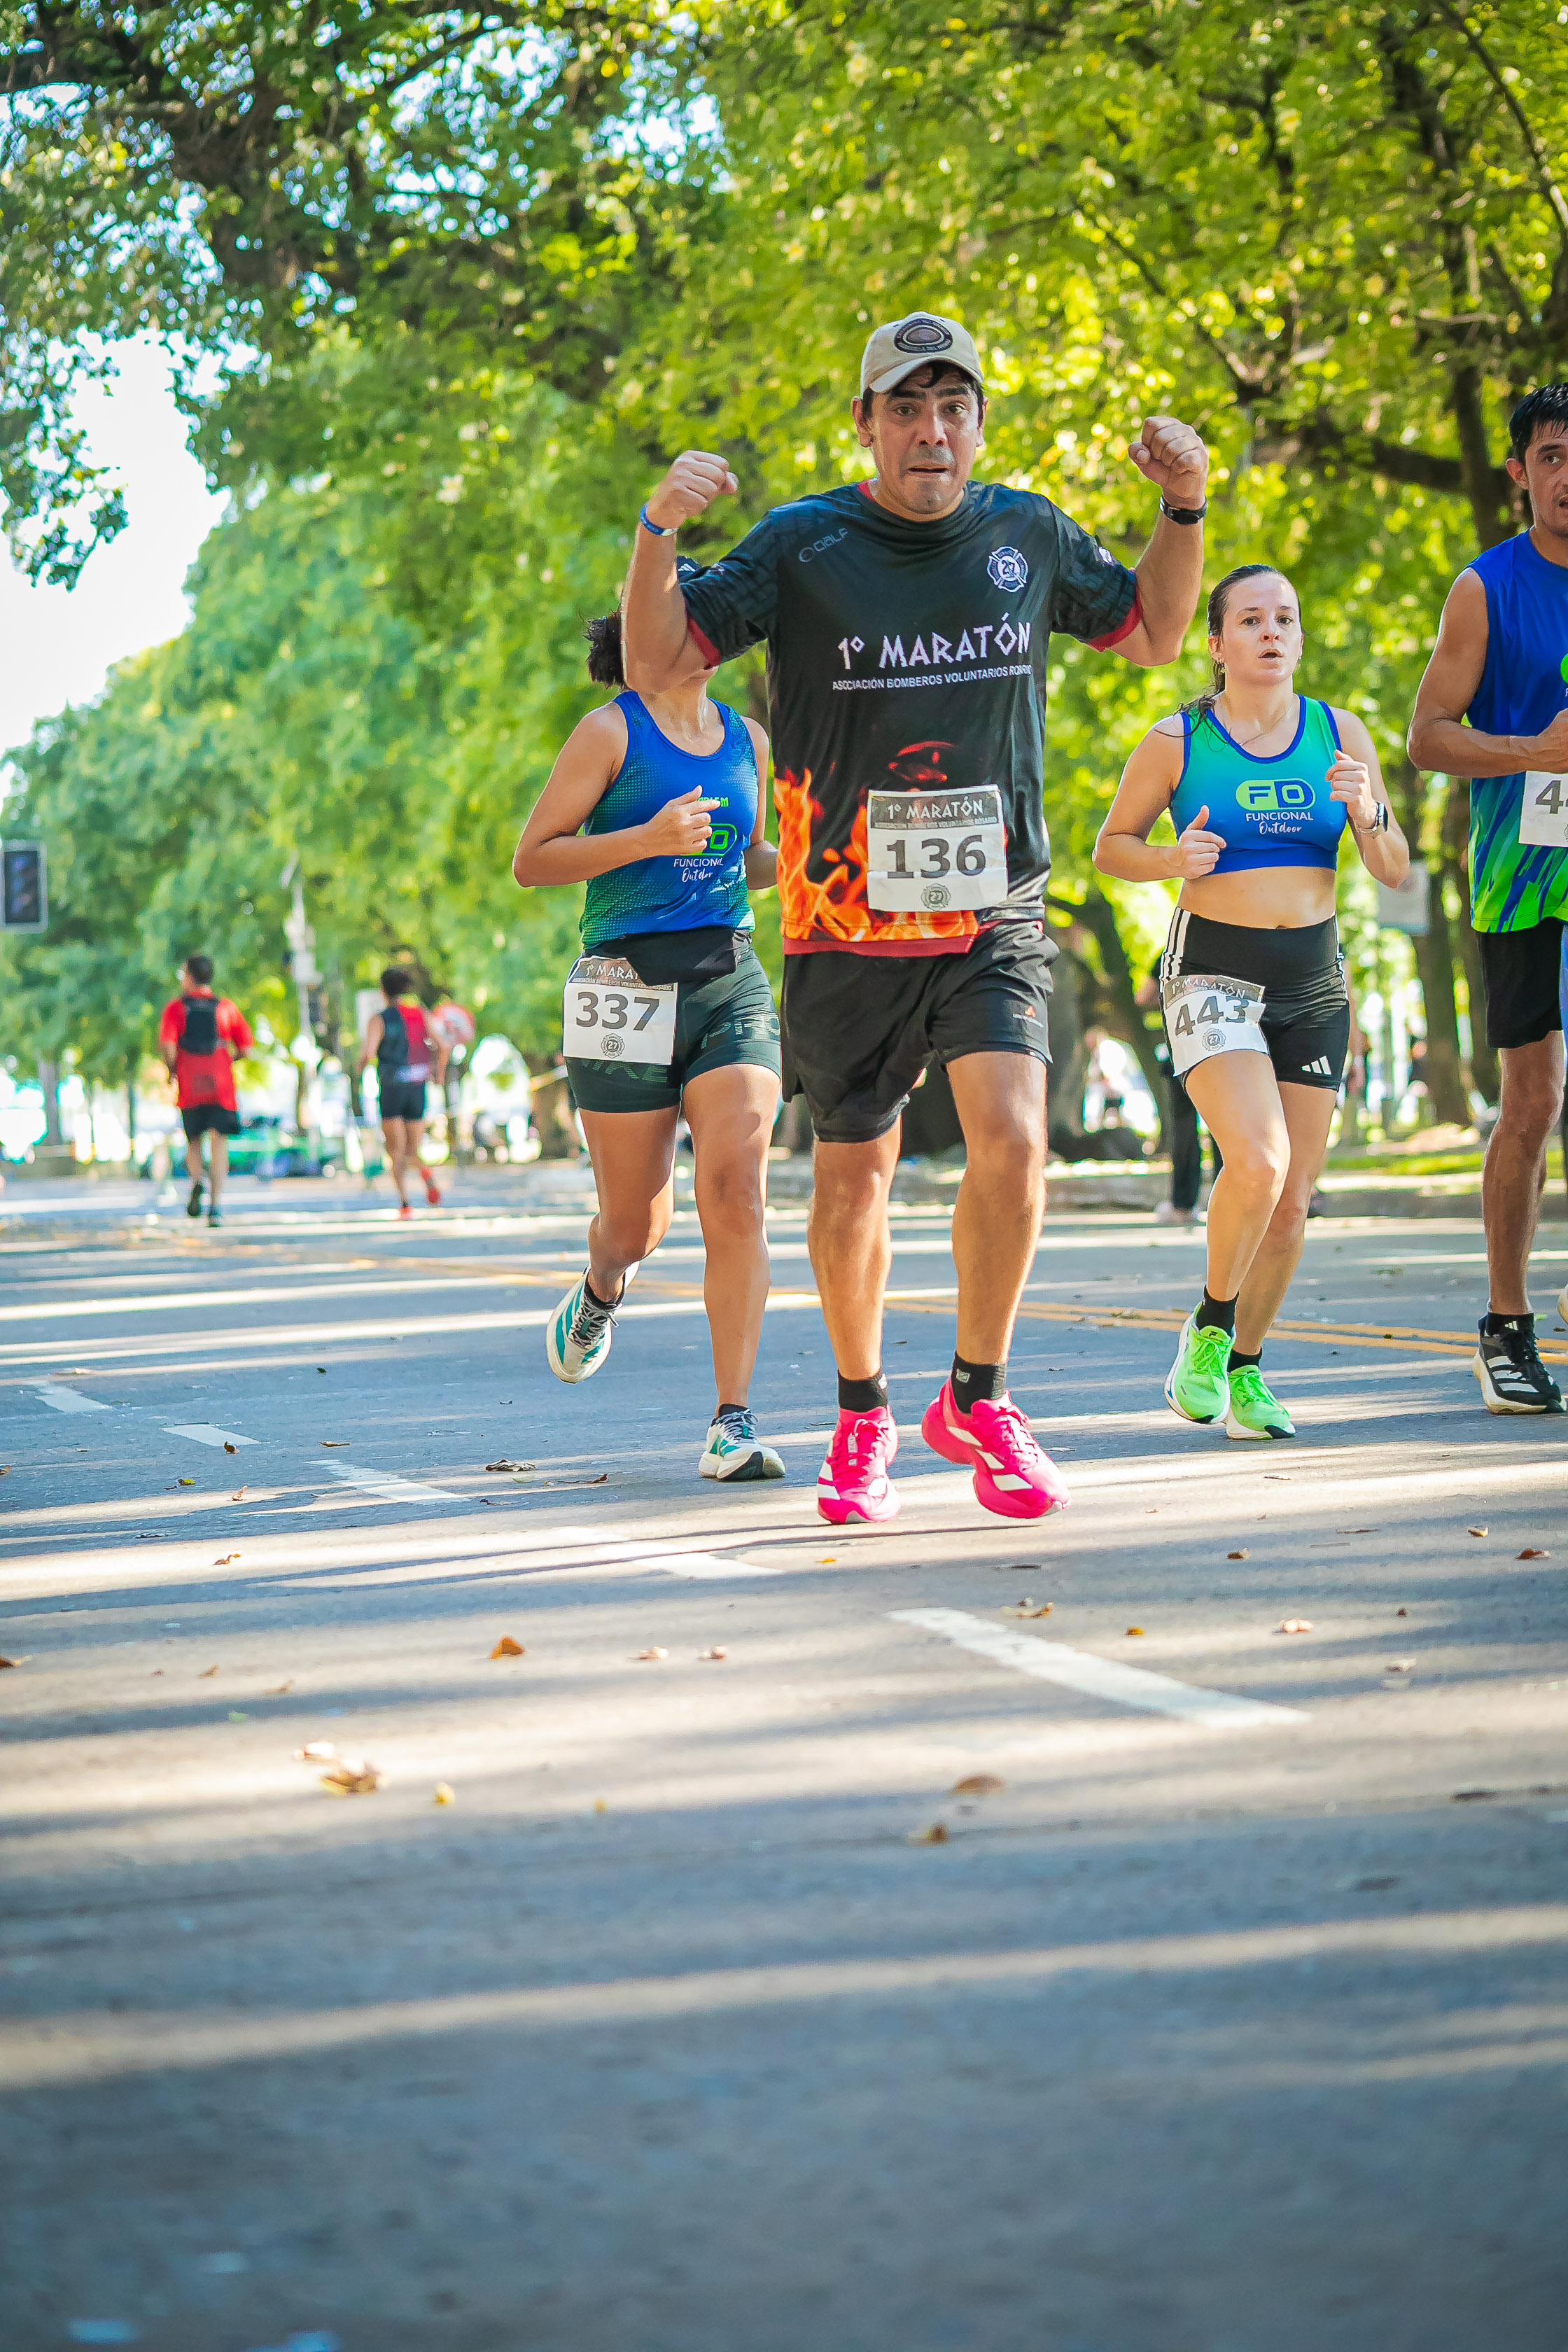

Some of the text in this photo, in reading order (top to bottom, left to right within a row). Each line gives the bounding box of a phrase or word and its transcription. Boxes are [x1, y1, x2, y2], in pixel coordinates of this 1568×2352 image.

[878, 612, 1031, 668] MARATÓN
[886, 673, 943, 688] BOMBEROS
[944, 666, 1008, 683] VOLUNTARIOS
[906, 795, 983, 820] MARATÓN
[1535, 780, 1568, 815] 4
[1246, 811, 1314, 821] FUNCIONAL
[1259, 820, 1302, 835] Outdoor
[886, 834, 986, 879] 136
[576, 991, 659, 1031] 337
[1175, 995, 1250, 1037] 443
[608, 1040, 618, 1049] 27
